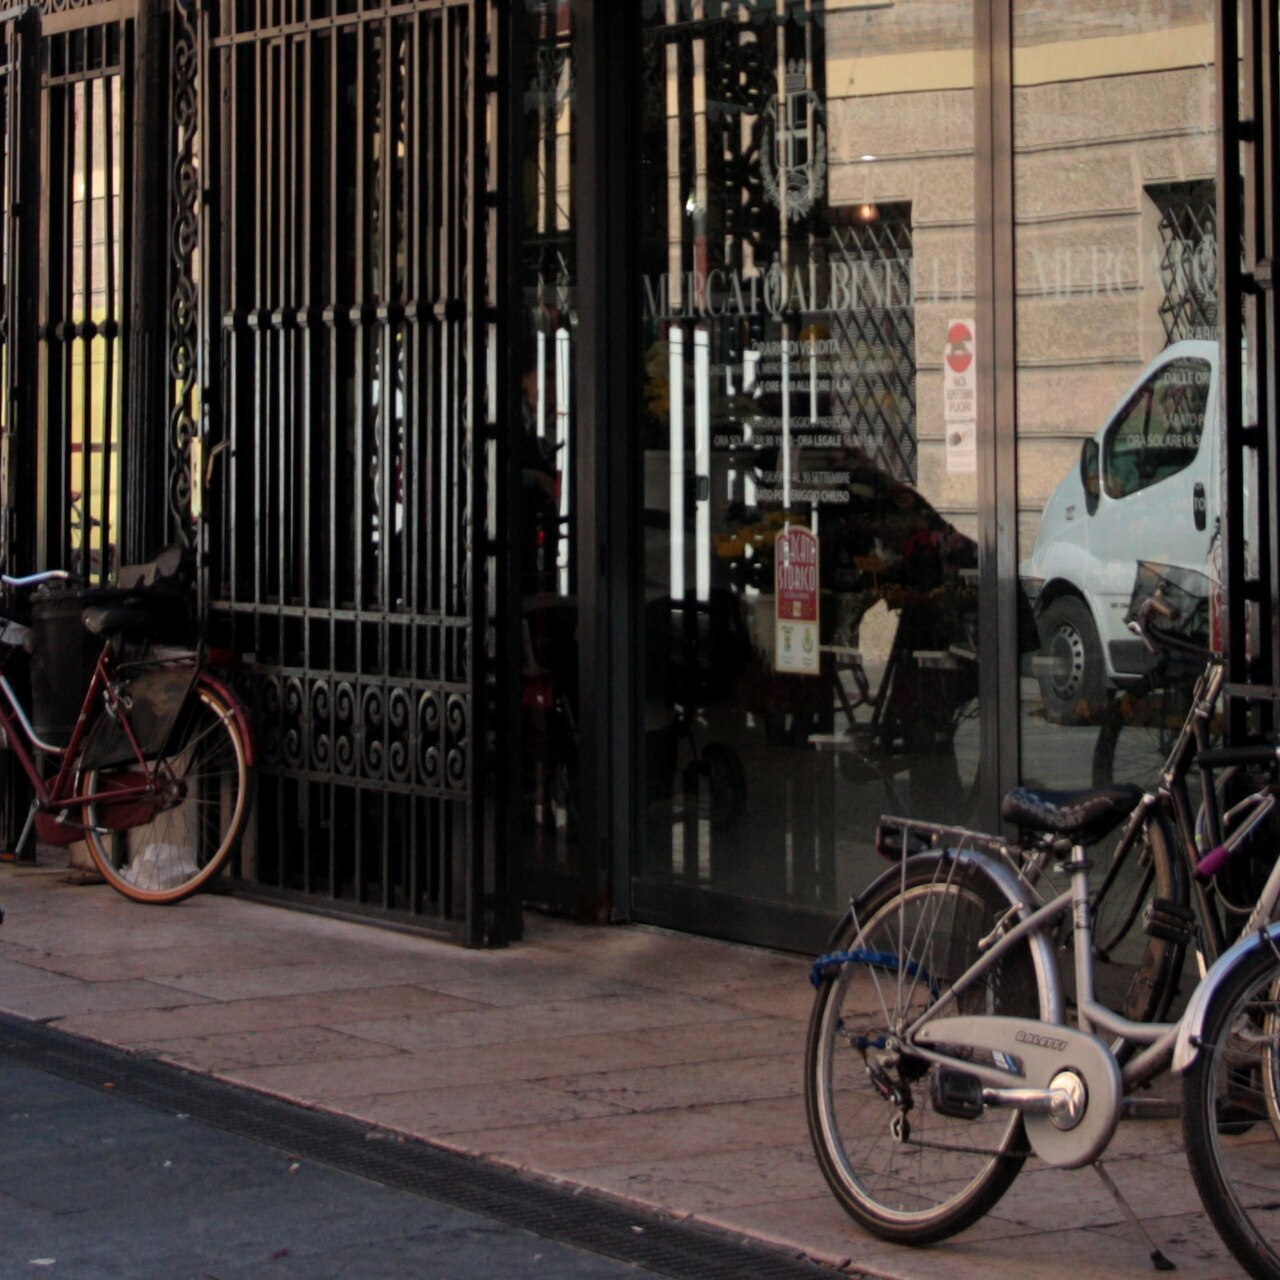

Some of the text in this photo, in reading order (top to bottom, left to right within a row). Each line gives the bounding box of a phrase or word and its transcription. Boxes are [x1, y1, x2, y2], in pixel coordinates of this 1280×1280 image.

[641, 253, 964, 321] MERCATO ALBINELLI
[800, 340, 840, 356] VEDITA
[1164, 372, 1193, 384] DALLE
[814, 435, 841, 448] LEGALE
[778, 565, 816, 591] STORICO
